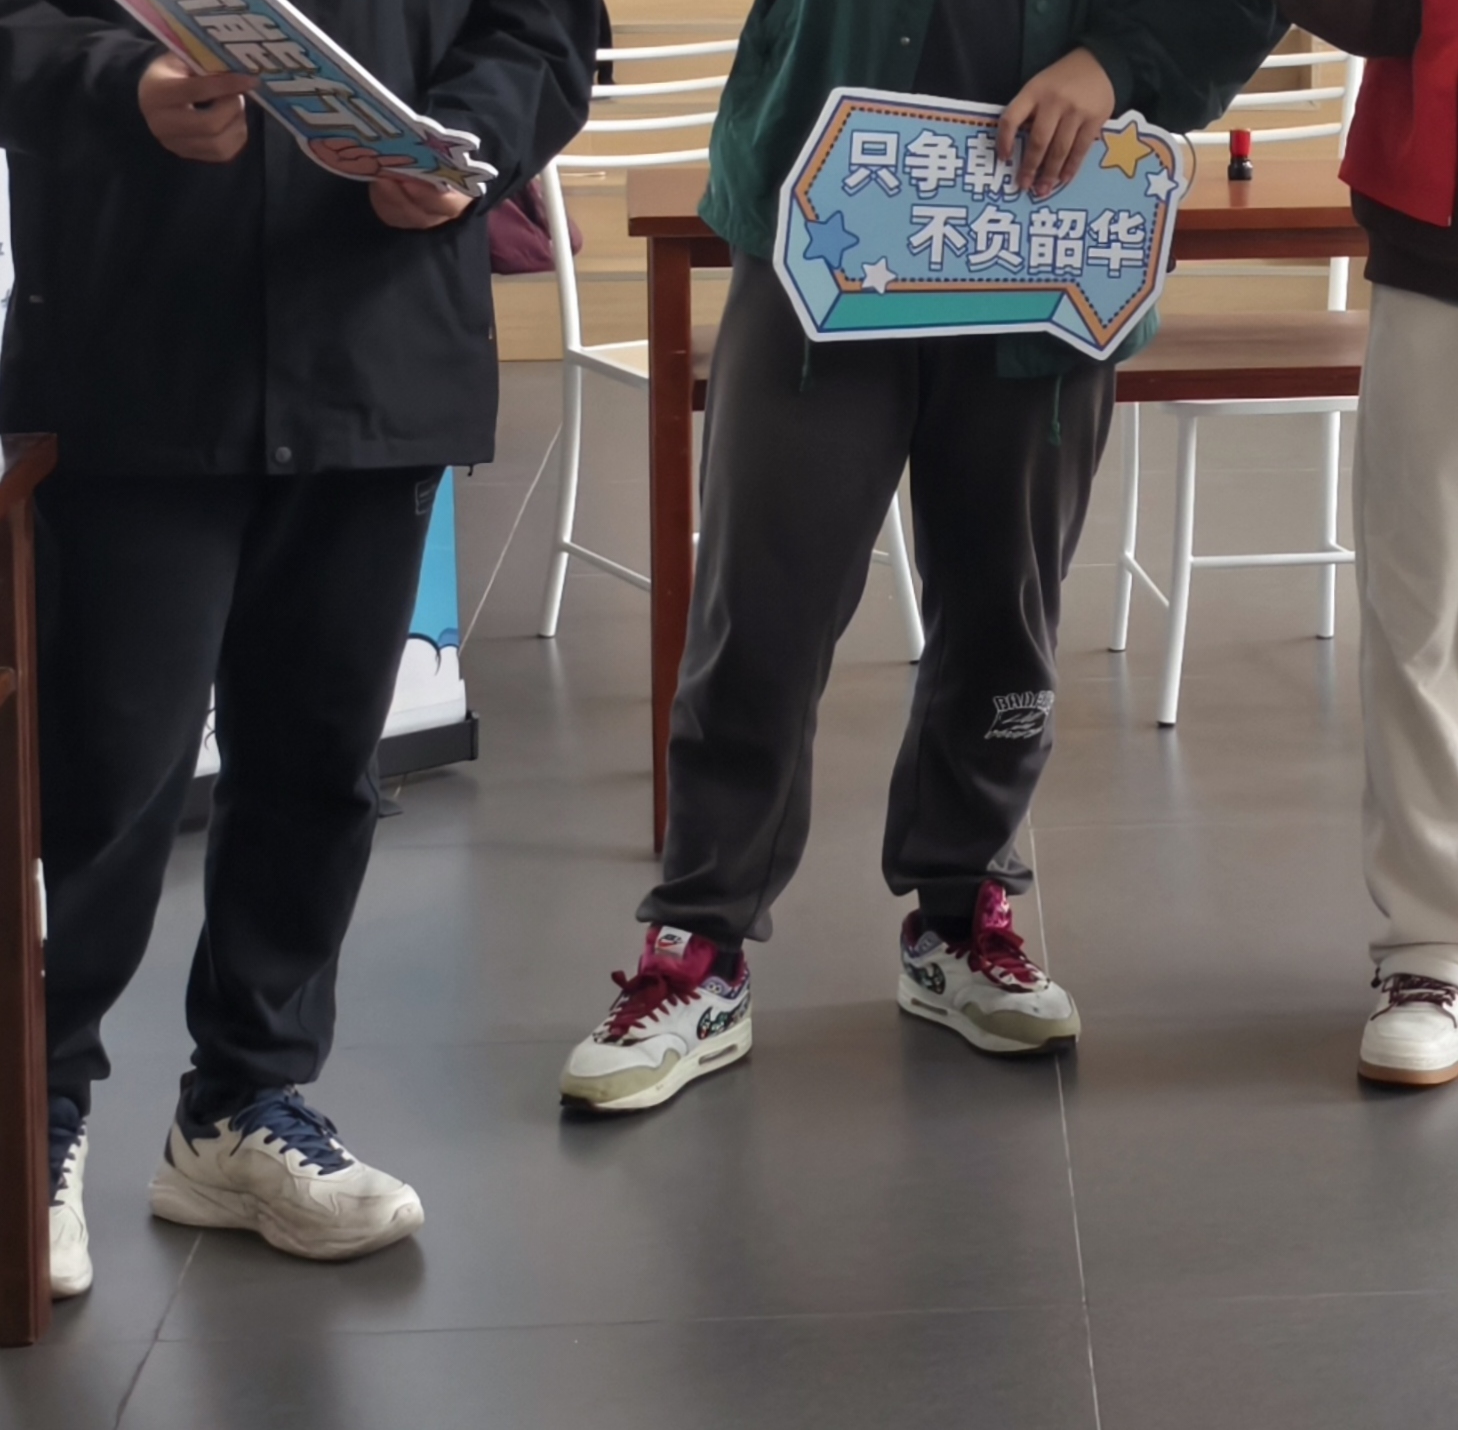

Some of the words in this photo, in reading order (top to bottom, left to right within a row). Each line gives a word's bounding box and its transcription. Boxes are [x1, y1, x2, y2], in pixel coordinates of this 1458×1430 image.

[841, 129, 1072, 205] 只争朝
[908, 204, 1148, 278] 不负韶华
